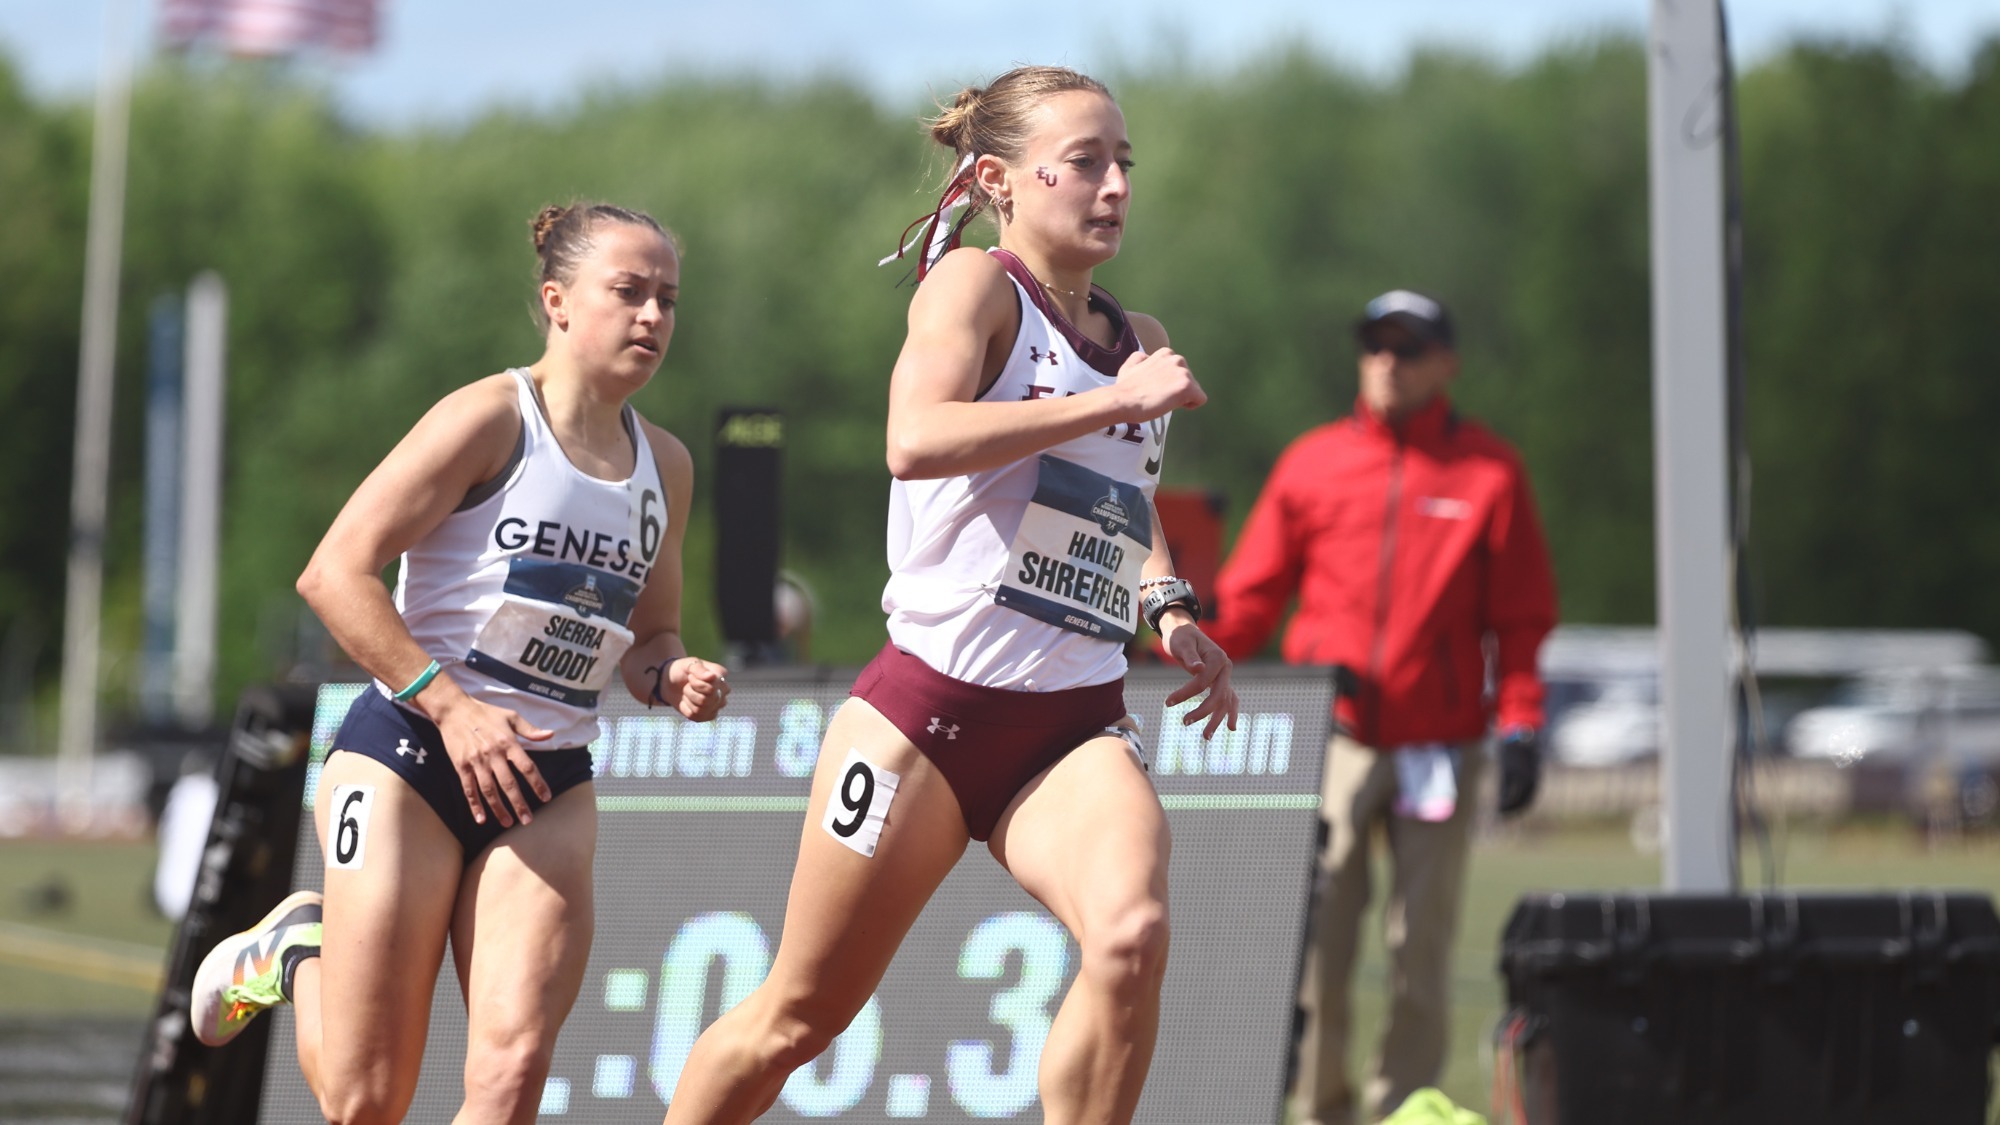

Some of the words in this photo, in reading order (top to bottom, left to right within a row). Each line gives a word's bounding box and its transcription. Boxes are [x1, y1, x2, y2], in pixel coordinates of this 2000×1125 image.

[1036, 166, 1058, 187] EU
[495, 517, 651, 584] GENESE
[640, 487, 661, 563] 6
[1067, 531, 1125, 573] HAILEY
[1018, 551, 1130, 623] SHREFFLER
[519, 637, 598, 684] DOODY
[544, 615, 606, 650] SIERRA
[588, 716, 757, 777] omen
[335, 790, 365, 864] 6
[831, 761, 875, 838] 9
